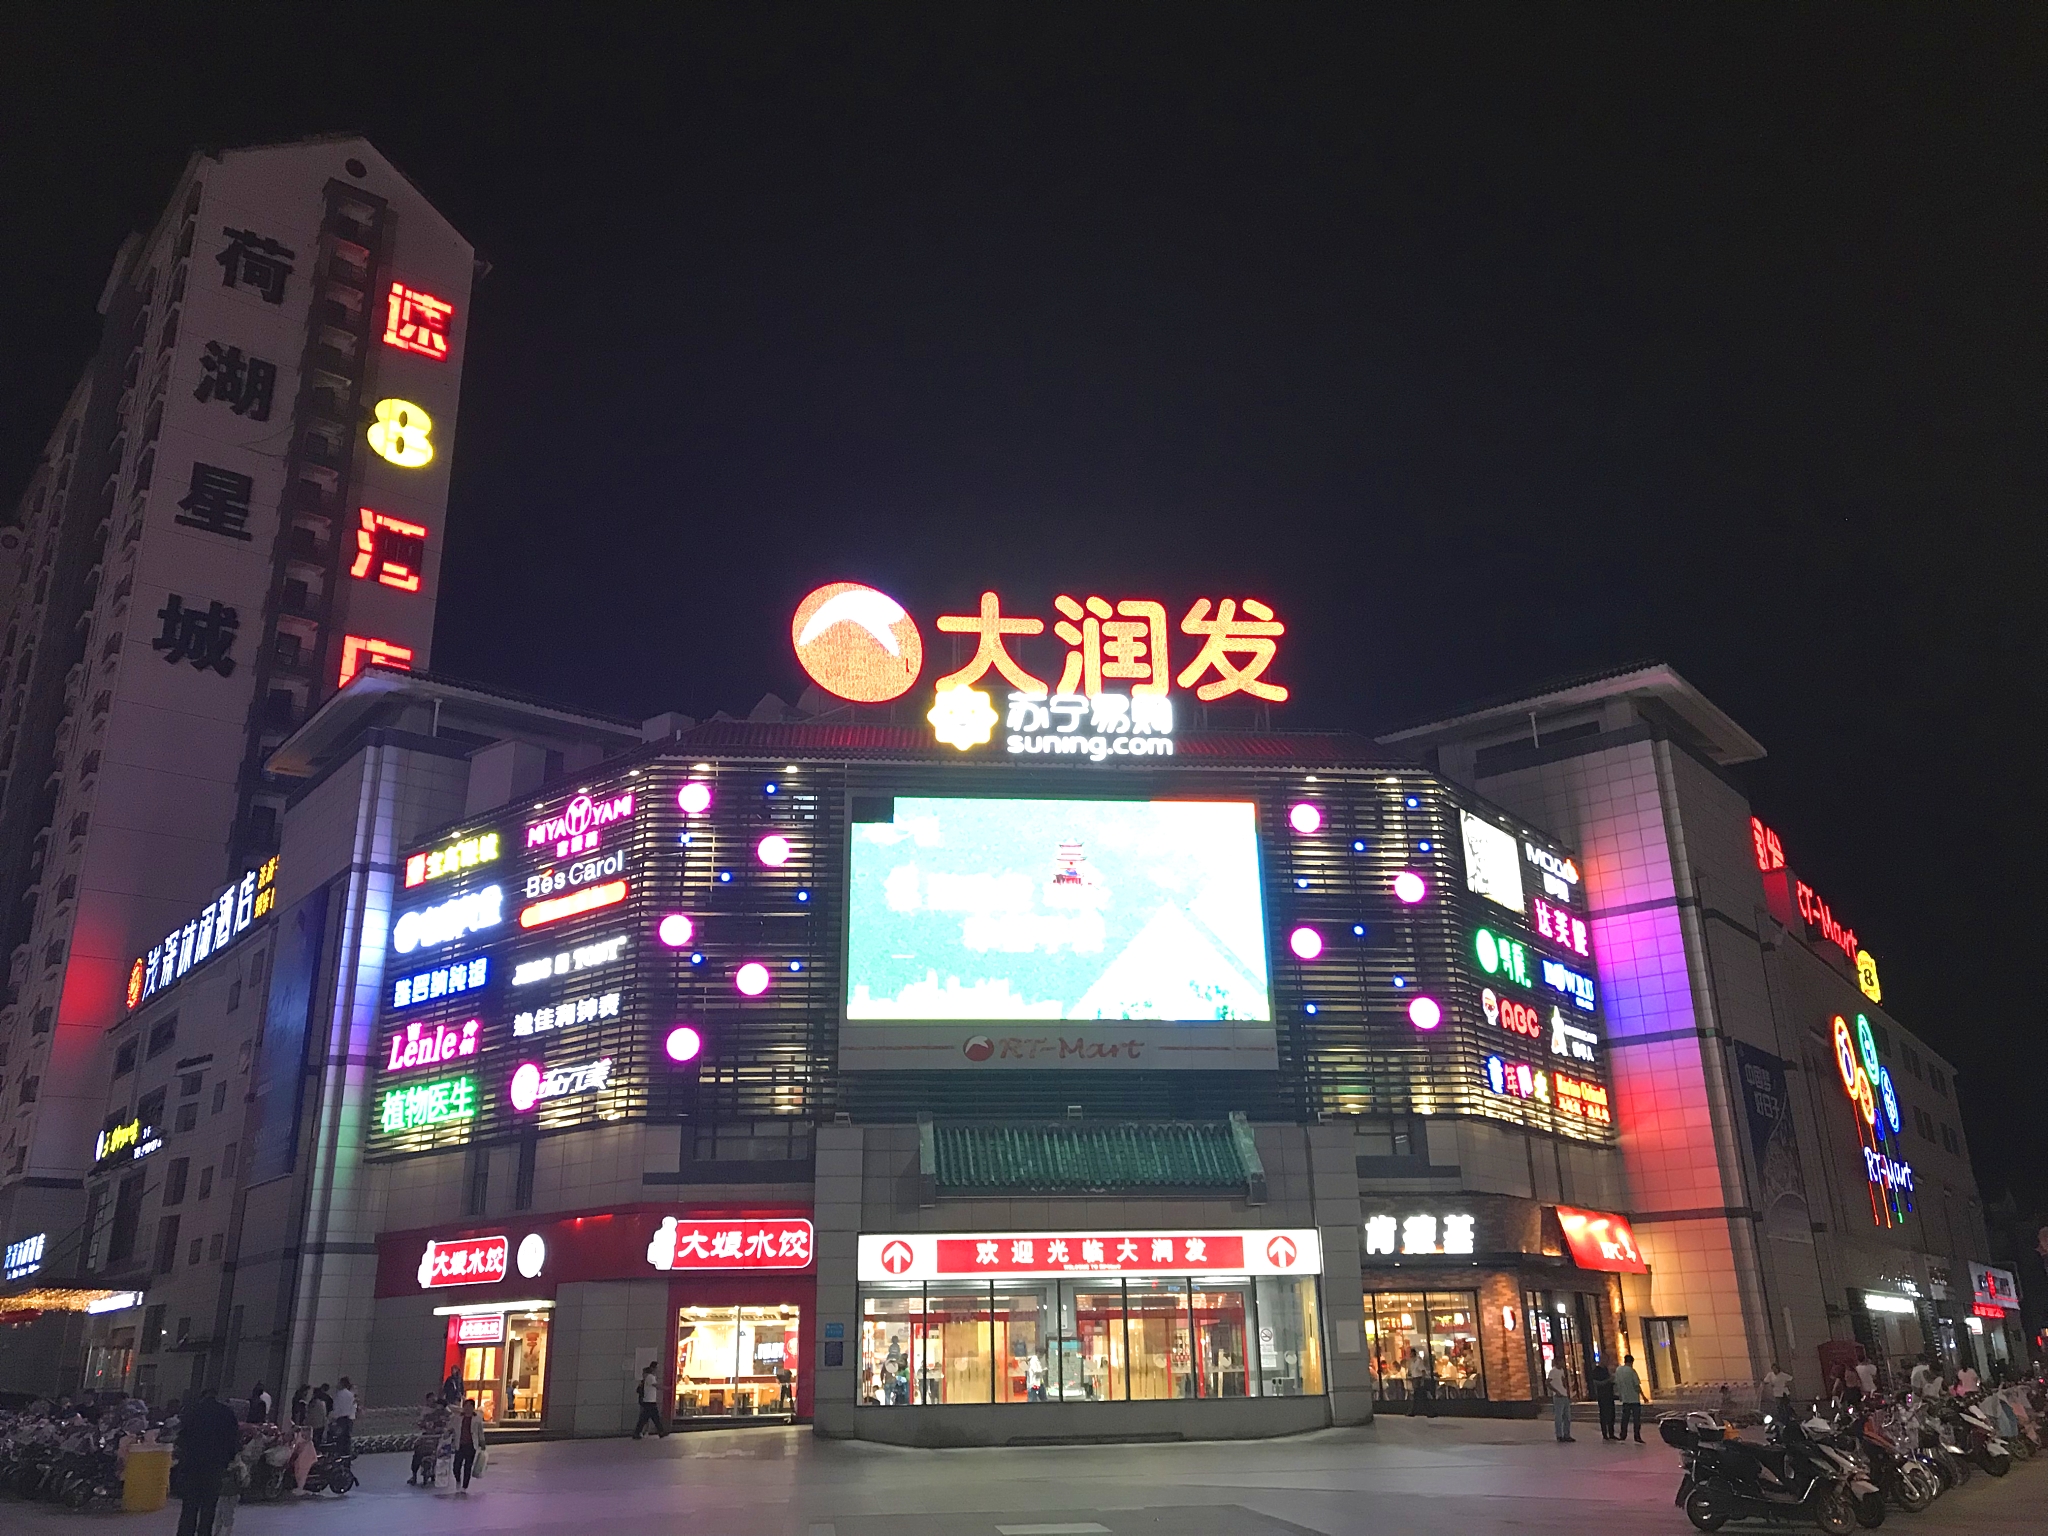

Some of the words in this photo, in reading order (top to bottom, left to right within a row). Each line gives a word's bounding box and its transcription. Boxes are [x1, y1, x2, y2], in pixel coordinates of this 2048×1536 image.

[153, 227, 295, 678] 荷湖星城
[935, 591, 1290, 702] 大润发
[1006, 691, 1174, 735] 苏宁易购
[1006, 733, 1174, 762] suning.com
[568, 849, 624, 885] Carol
[1863, 968, 1875, 987] 8
[1500, 999, 1541, 1038] ABC
[387, 1024, 457, 1071] Lenle
[998, 1036, 1146, 1060] RT-Mart
[381, 1076, 475, 1133] 植物医生
[1863, 1146, 1914, 1193] RT-Mart
[432, 1246, 504, 1278] 大娘水饺
[677, 1228, 810, 1259] 大娘水饺
[975, 1237, 1208, 1264] 欢迎光临大润发
